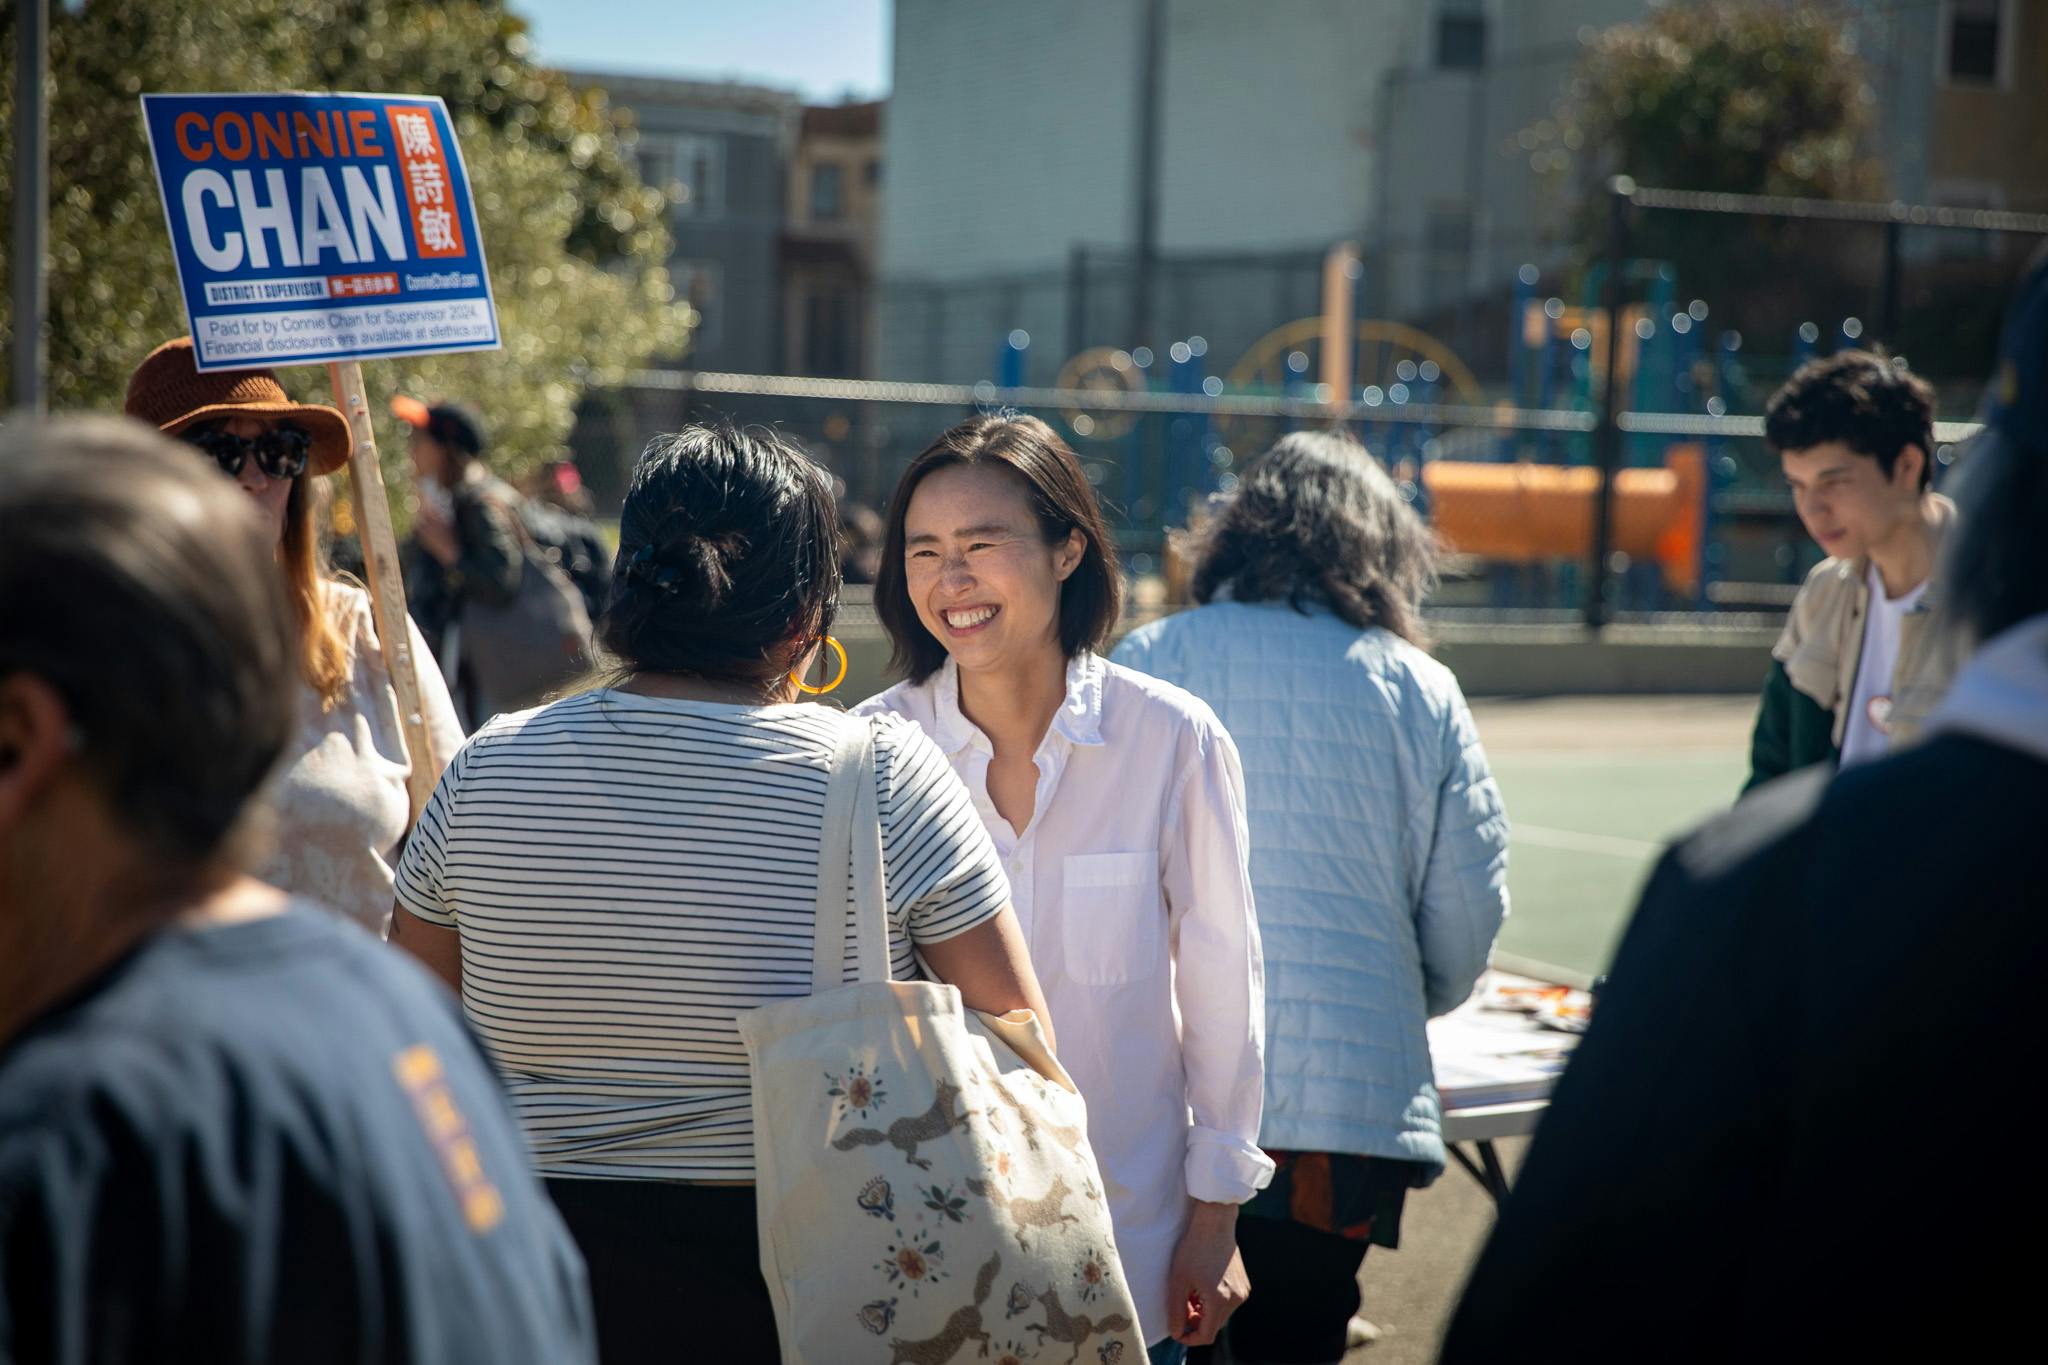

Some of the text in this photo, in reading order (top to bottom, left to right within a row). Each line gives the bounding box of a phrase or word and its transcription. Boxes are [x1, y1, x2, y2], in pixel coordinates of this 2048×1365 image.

[174, 110, 385, 162] CONNIE
[395, 113, 458, 251] 陳詩敏
[181, 164, 408, 272] CHAN
[211, 285, 254, 301] DISTRICT
[265, 281, 324, 298] SUPERVISOR
[206, 338, 264, 356] Financial
[266, 335, 335, 353] disclosures
[336, 334, 358, 346] are
[361, 328, 413, 343] available
[415, 328, 426, 339] at
[209, 320, 240, 337] Paid
[242, 319, 260, 335] for
[262, 319, 279, 336] by
[281, 316, 325, 332] Connie
[328, 312, 362, 328] Chan
[365, 311, 383, 326] for
[385, 308, 445, 325] Supervisor
